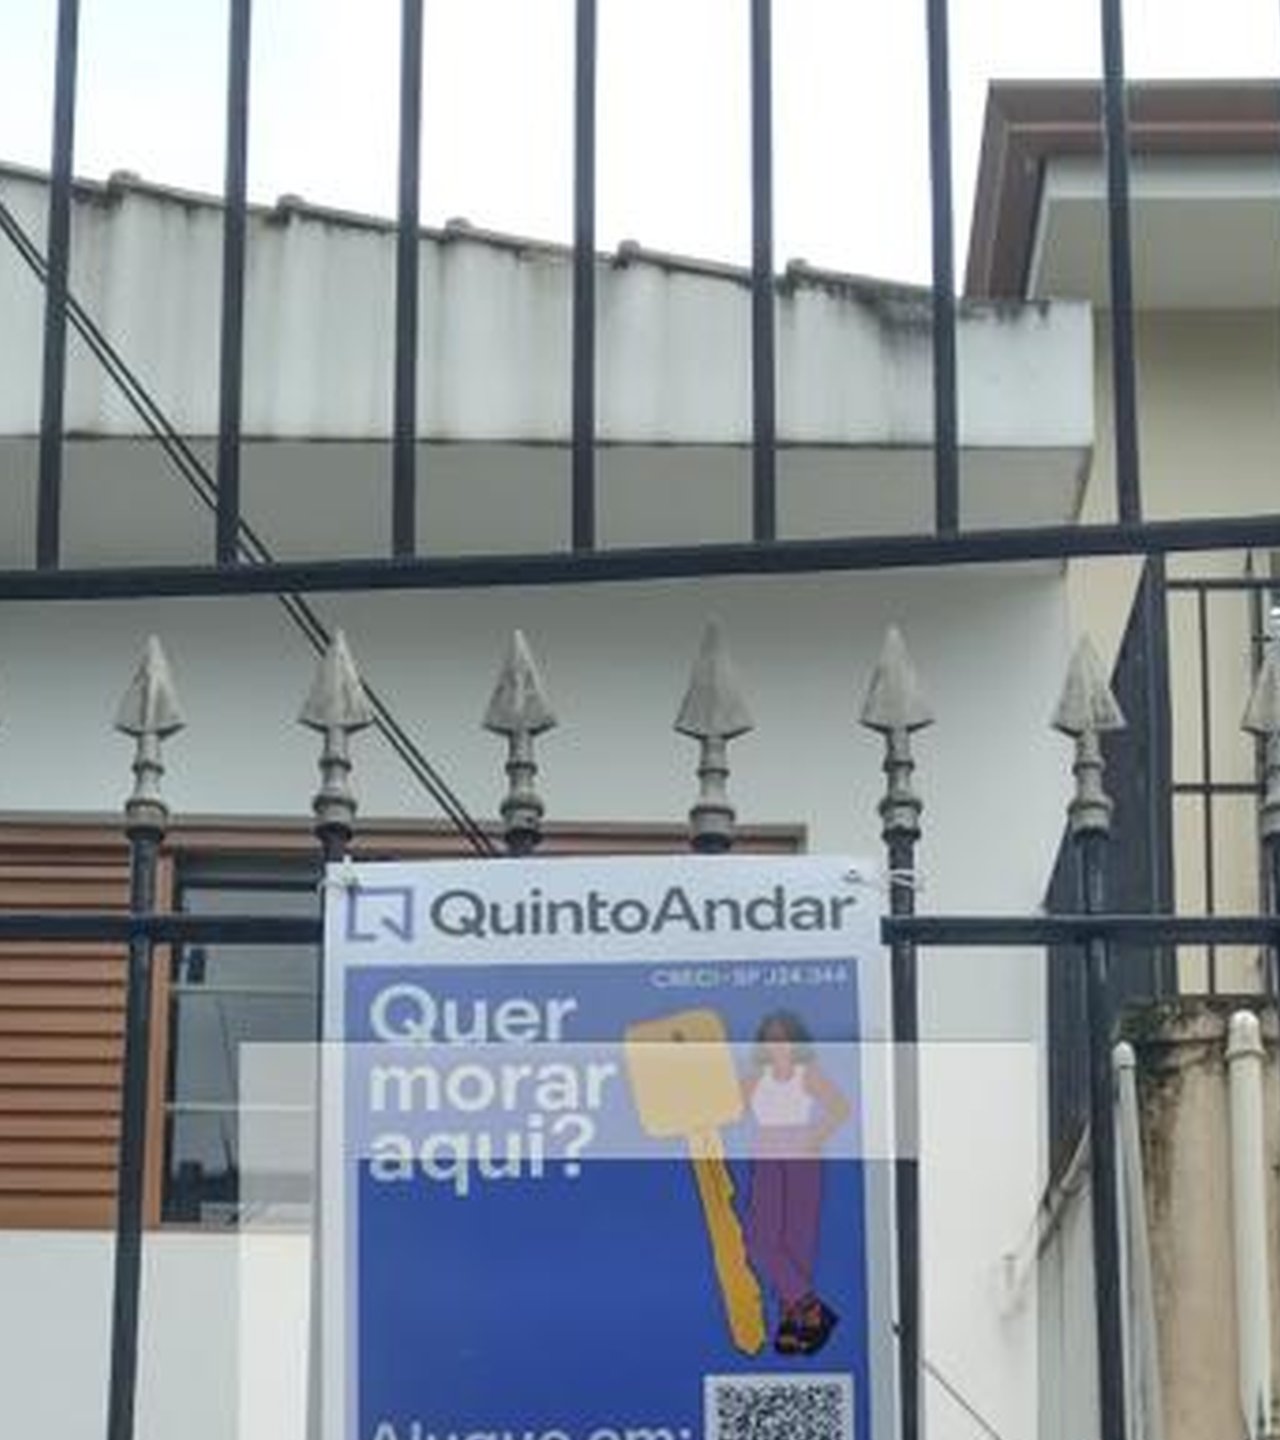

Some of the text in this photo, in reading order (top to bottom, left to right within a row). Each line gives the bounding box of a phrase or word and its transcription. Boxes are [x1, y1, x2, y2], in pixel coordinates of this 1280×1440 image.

[429, 886, 857, 938] QuintoAndar
[369, 983, 578, 1044] Quer
[369, 1060, 617, 1112] morar
[368, 1114, 596, 1196] aqui?
